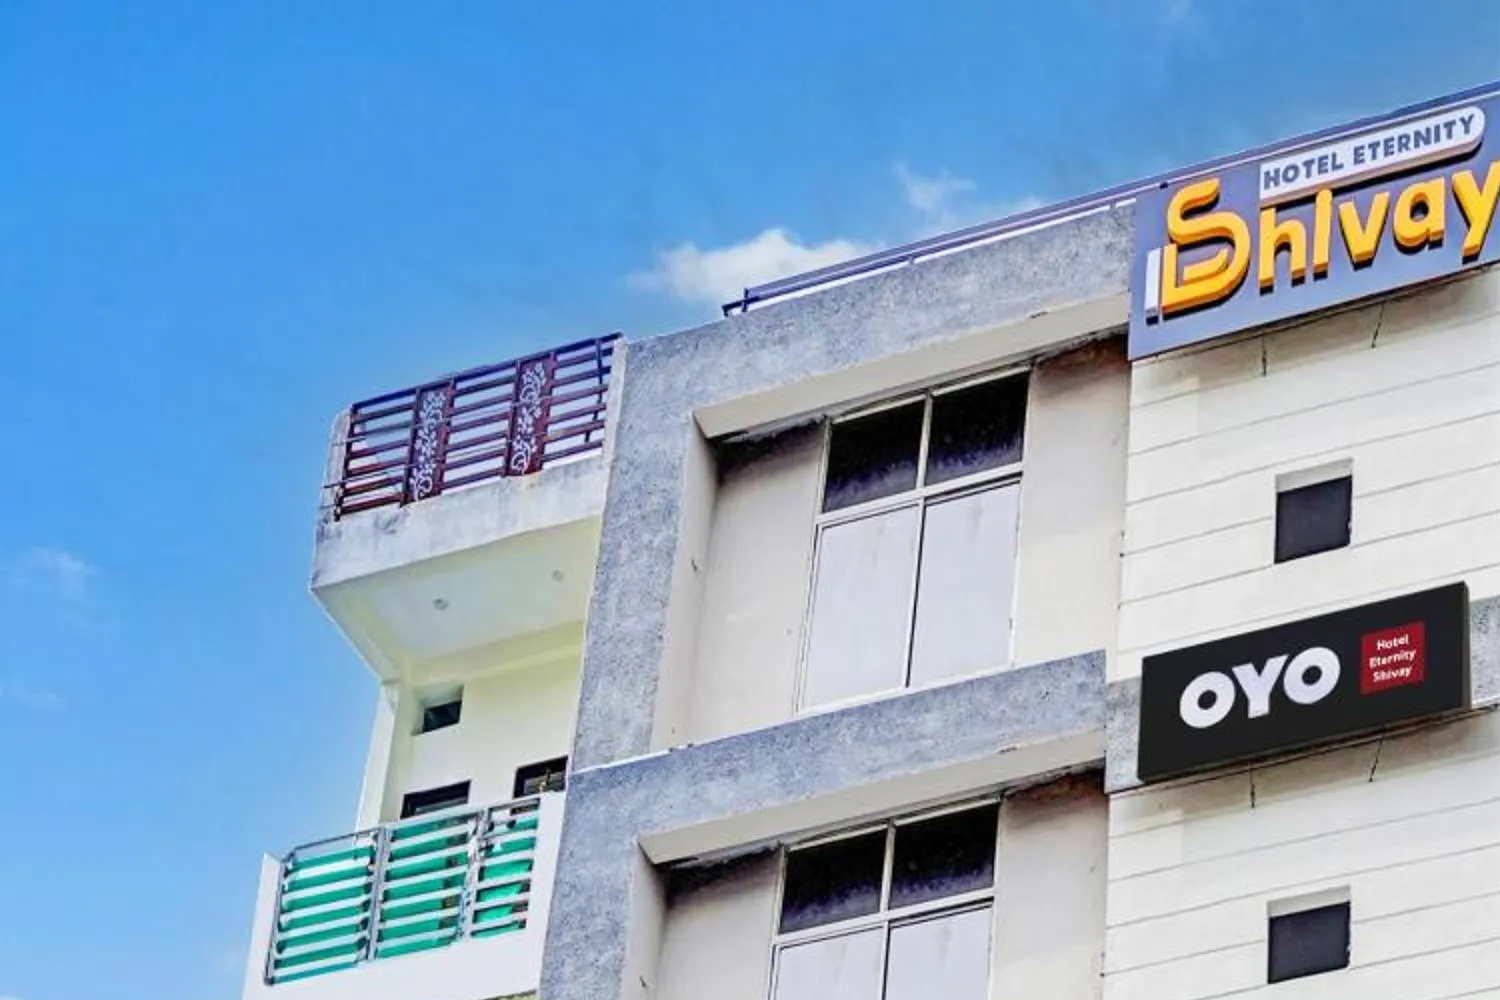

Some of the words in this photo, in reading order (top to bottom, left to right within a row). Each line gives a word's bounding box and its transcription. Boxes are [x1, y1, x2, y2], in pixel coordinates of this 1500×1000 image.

[1263, 154, 1344, 191] HOTEL
[1353, 113, 1476, 166] ETERNITY
[1376, 633, 1409, 650] Hotel
[1369, 649, 1416, 669] Eternity
[1373, 666, 1412, 683] Shivay
[1180, 646, 1341, 729] OYO
